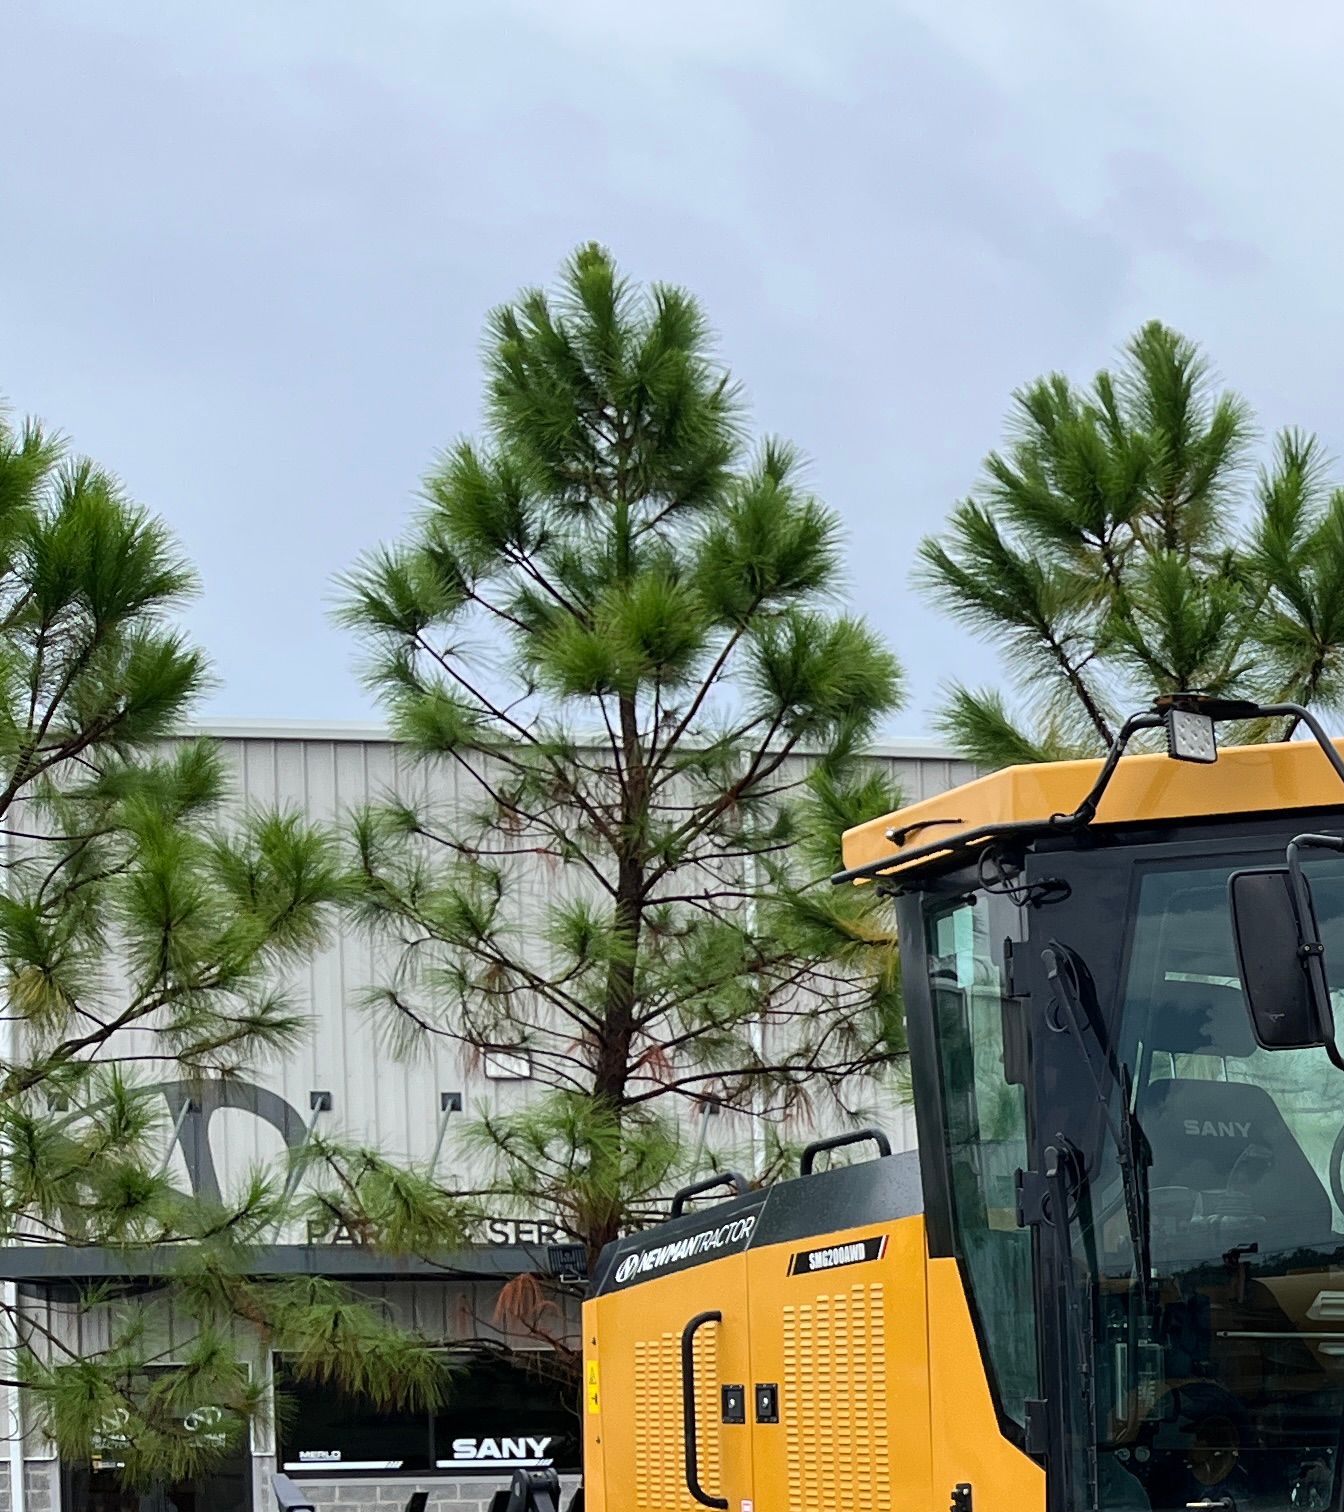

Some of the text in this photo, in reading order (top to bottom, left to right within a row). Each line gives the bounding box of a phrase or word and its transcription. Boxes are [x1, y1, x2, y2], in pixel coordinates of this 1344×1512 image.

[1184, 1119, 1252, 1138] SANY
[807, 1242, 867, 1272] SMG200AWD
[298, 1450, 342, 1460] MERLO
[451, 1436, 552, 1460] SANY
